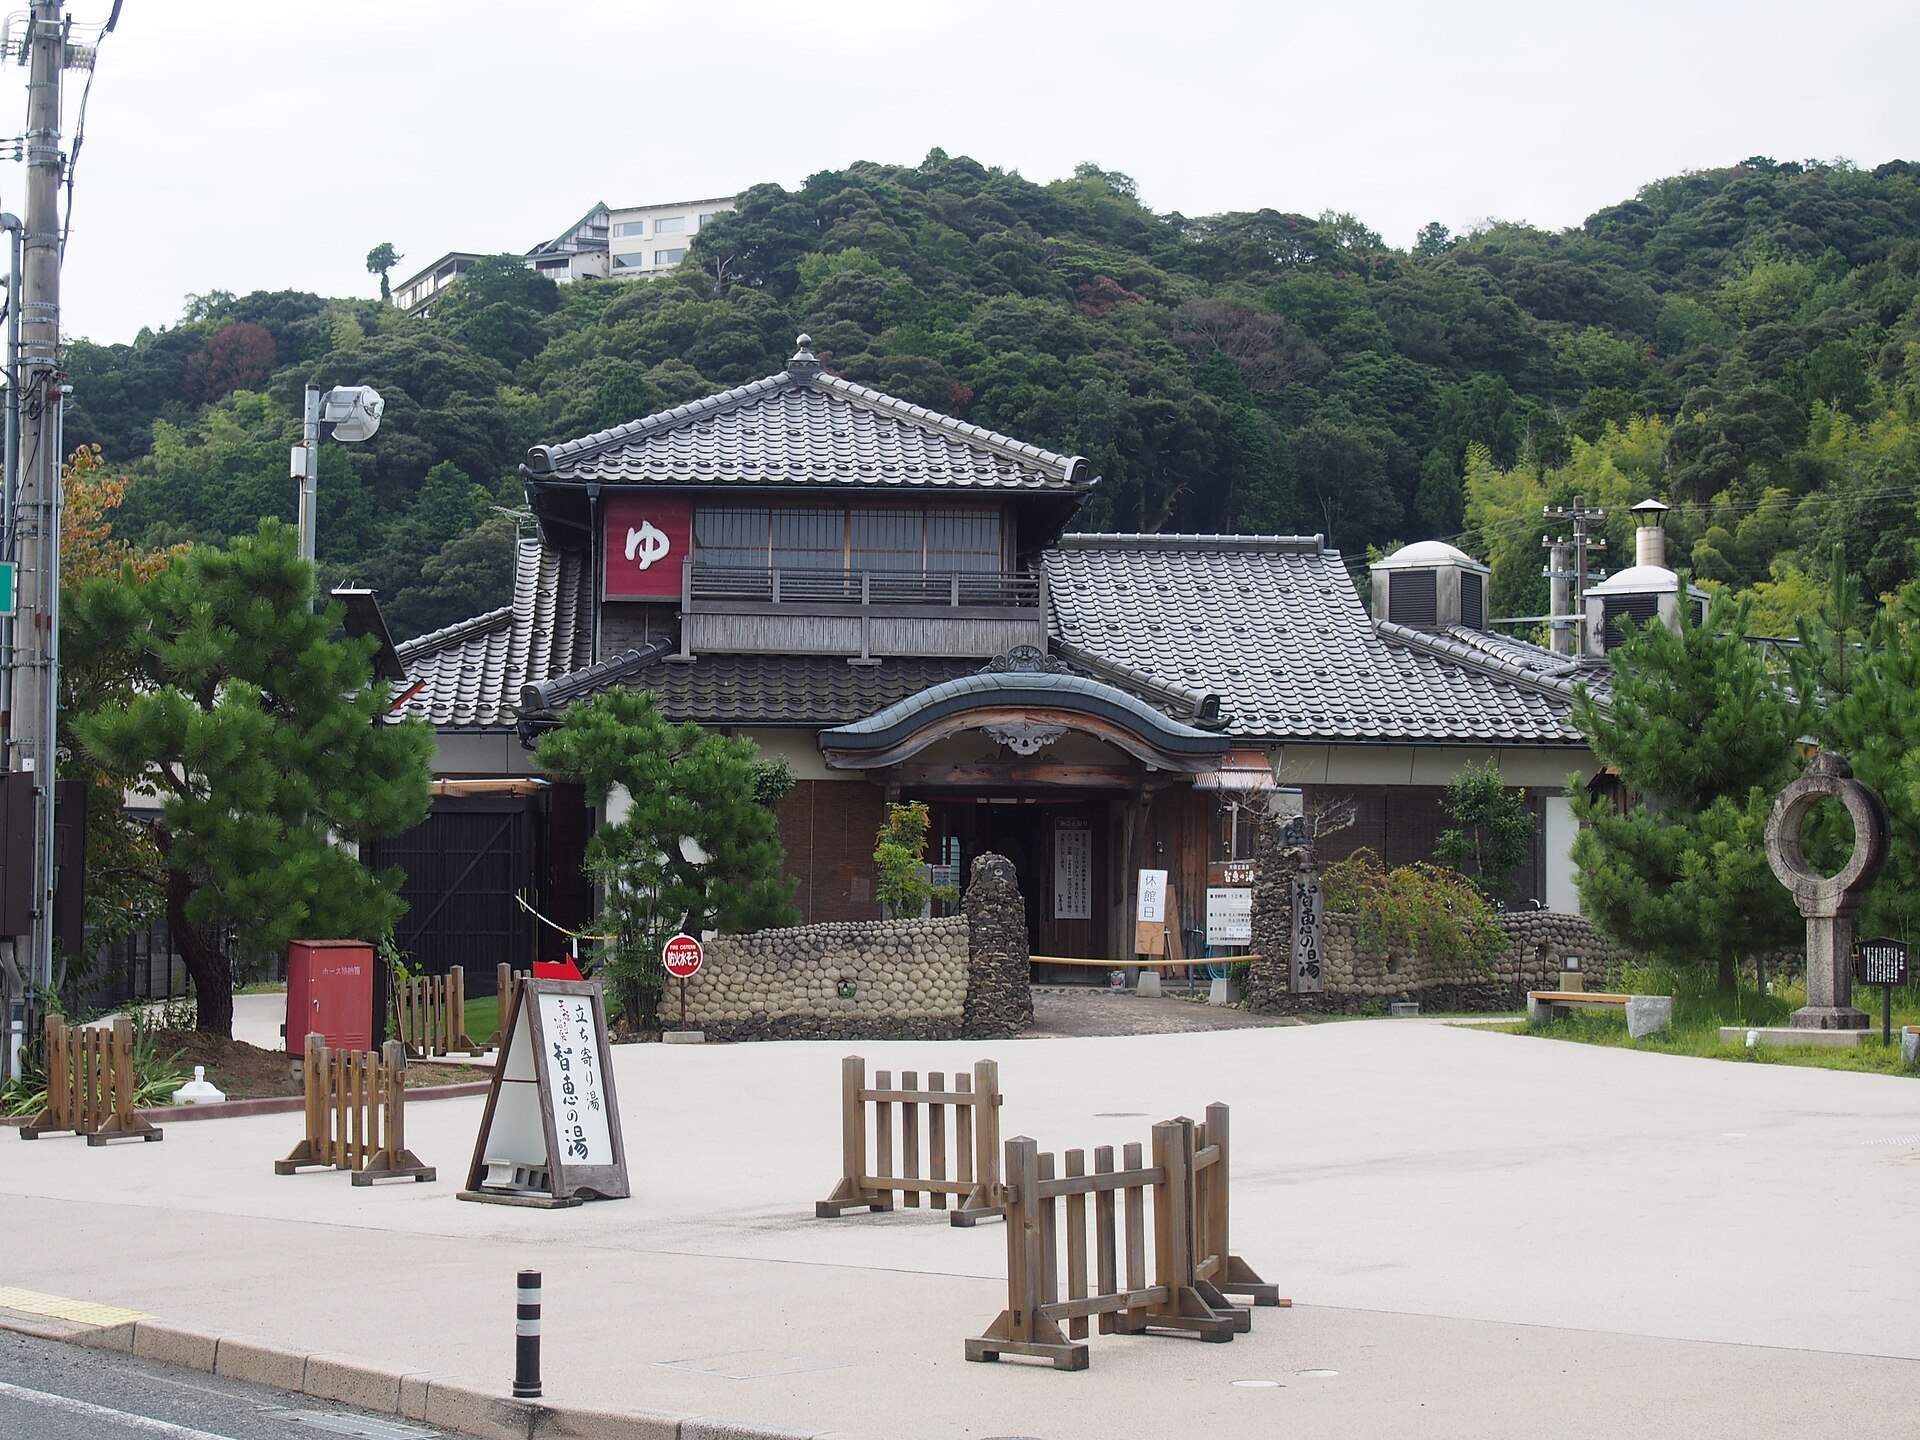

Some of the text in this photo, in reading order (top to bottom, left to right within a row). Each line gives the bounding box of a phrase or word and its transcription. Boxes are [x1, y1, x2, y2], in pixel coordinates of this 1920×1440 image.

[624, 520, 670, 570] ゆ
[1143, 873, 1157, 918] 休館日
[1296, 882, 1321, 980] 智恵の湯
[668, 951, 699, 967] 防火水そう
[575, 1004, 600, 1111] 立ち寄り湯
[553, 1042, 588, 1159] 智恵の湯
